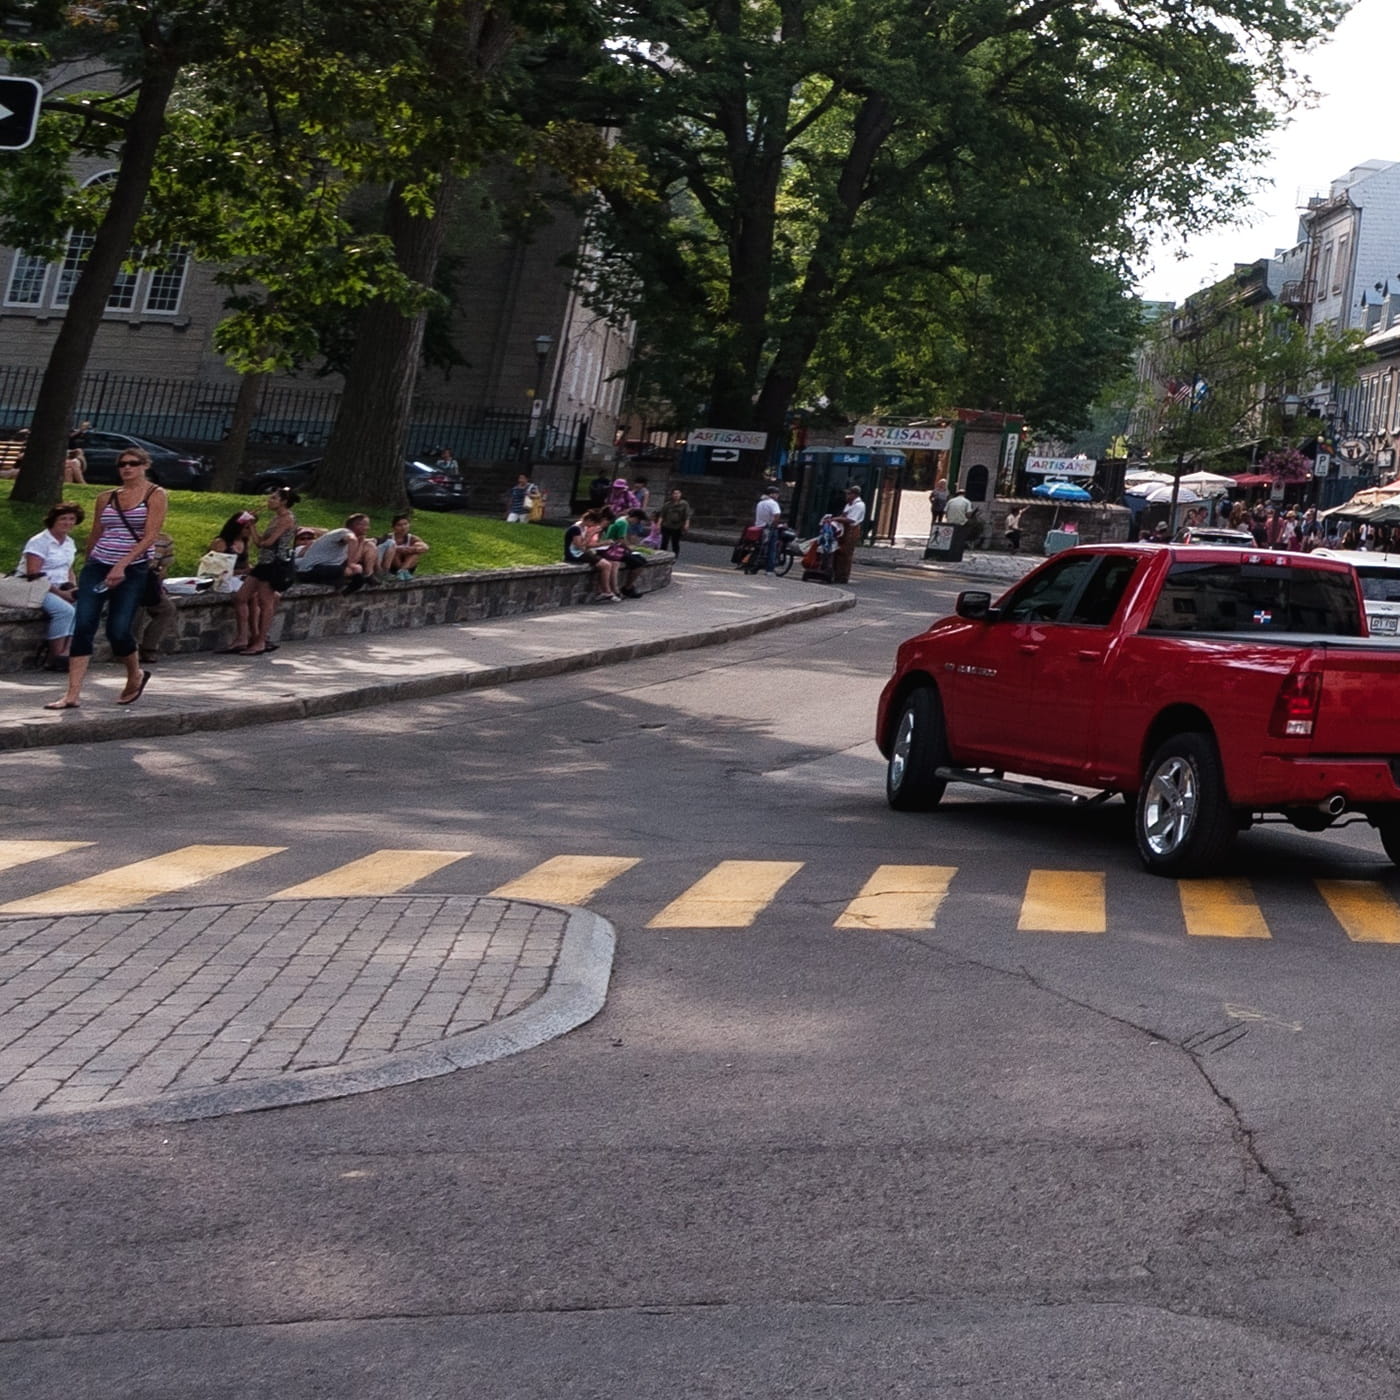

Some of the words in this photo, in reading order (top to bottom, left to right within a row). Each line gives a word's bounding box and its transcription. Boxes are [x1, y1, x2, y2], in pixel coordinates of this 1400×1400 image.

[694, 431, 760, 445] ARTISANS
[862, 427, 945, 442] ARTISANS
[843, 454, 859, 463] Bell
[1030, 459, 1091, 473] ARTISANS
